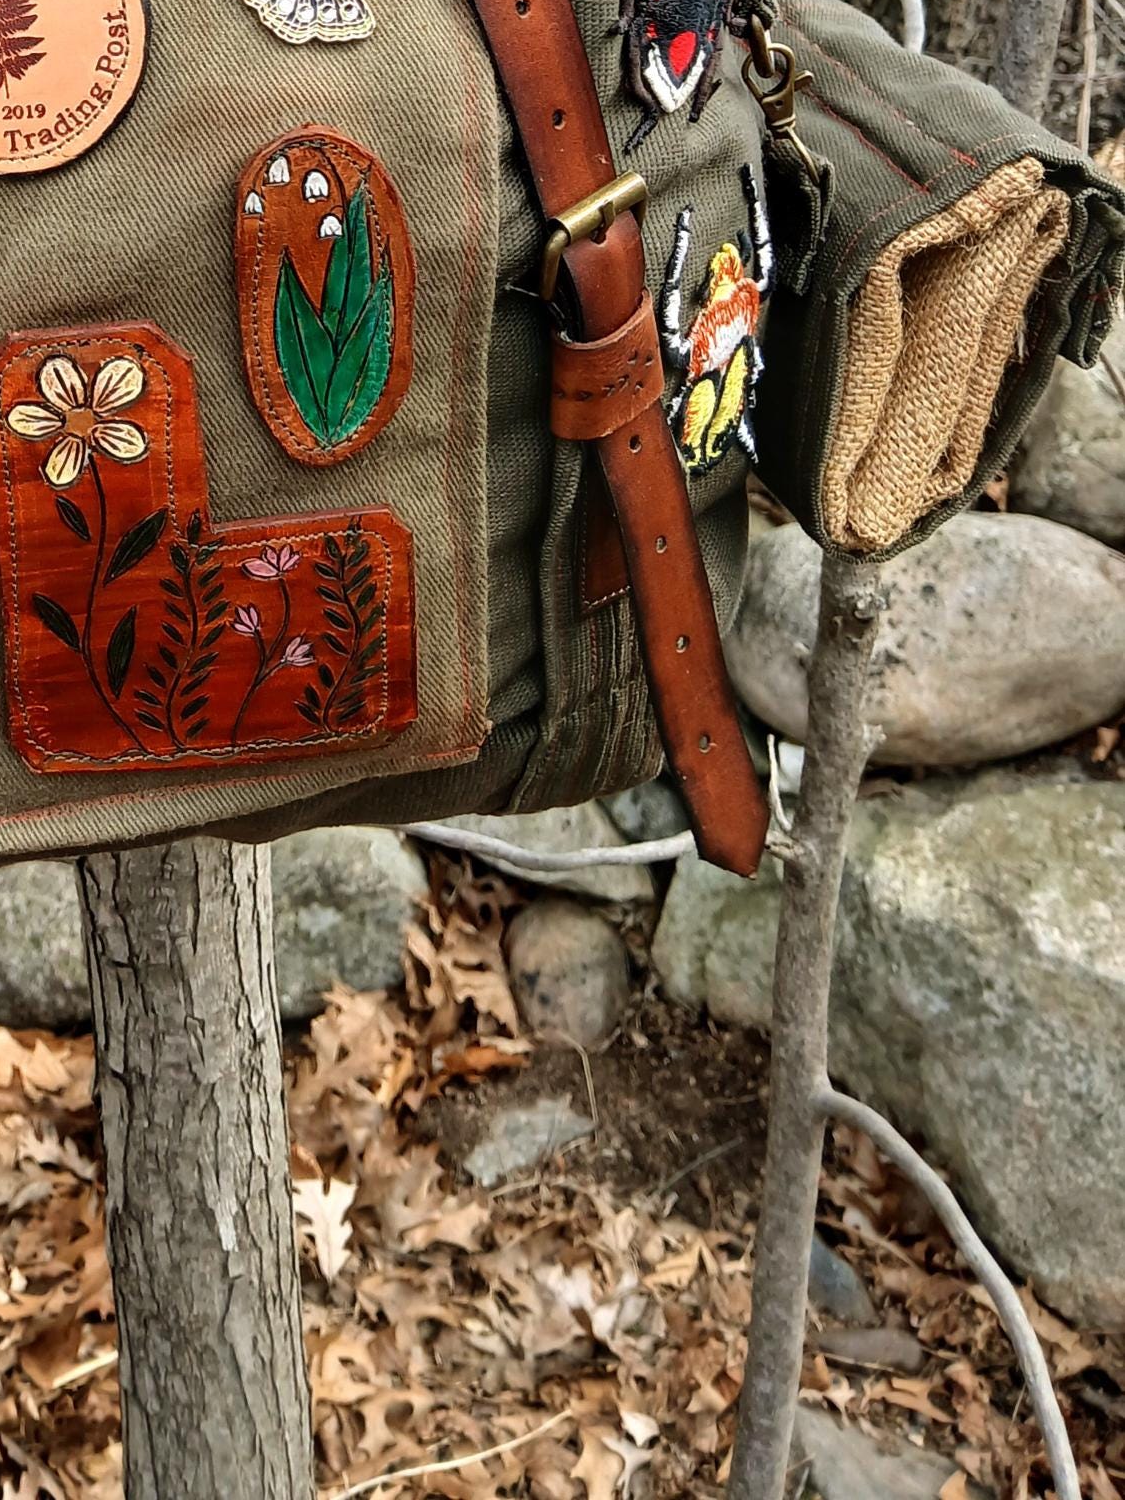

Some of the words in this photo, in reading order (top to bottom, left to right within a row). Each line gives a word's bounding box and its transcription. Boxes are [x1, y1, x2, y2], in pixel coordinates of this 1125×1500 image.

[2, 103, 47, 120] 2019
[4, 82, 113, 152] Trading
[95, 10, 128, 78] Post
